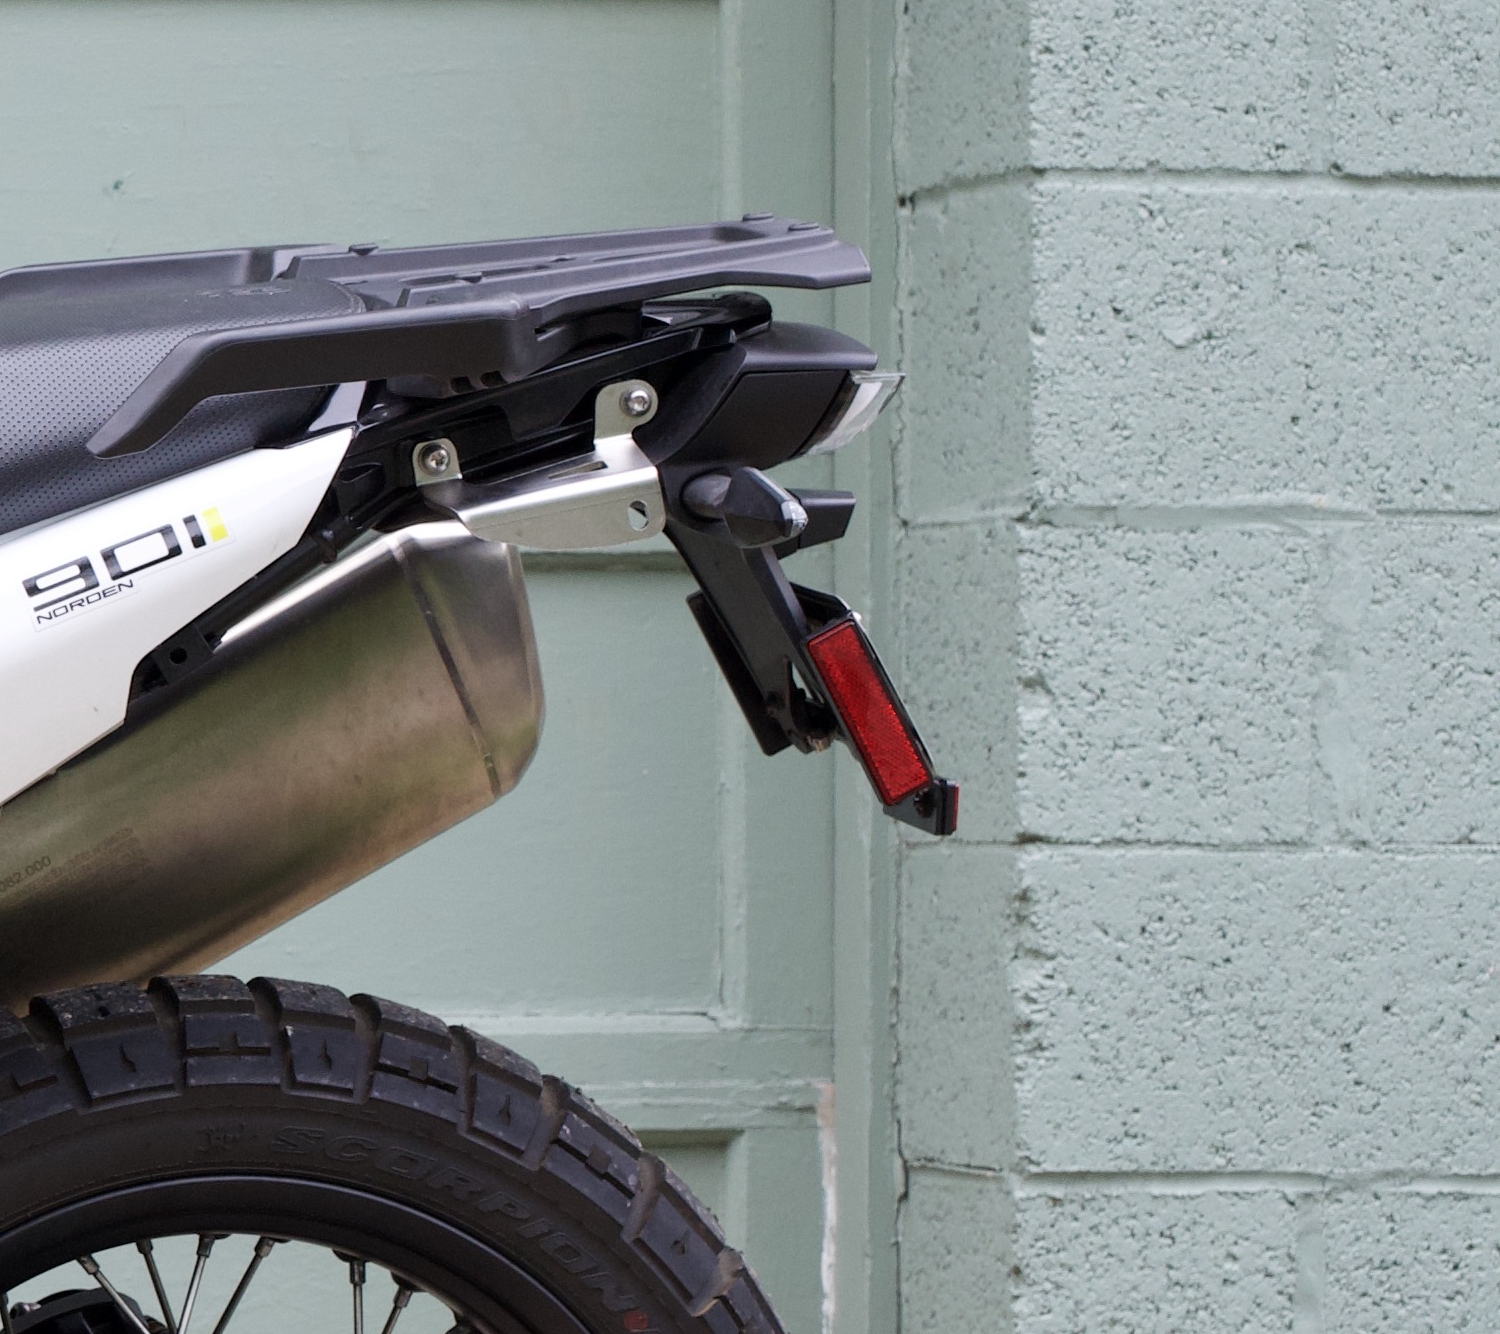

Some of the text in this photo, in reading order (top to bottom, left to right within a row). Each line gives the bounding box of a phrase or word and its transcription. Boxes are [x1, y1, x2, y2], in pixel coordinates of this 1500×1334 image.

[22, 515, 206, 612] 901
[36, 580, 134, 624] NORDEN
[272, 1125, 635, 1315] SCORPION
